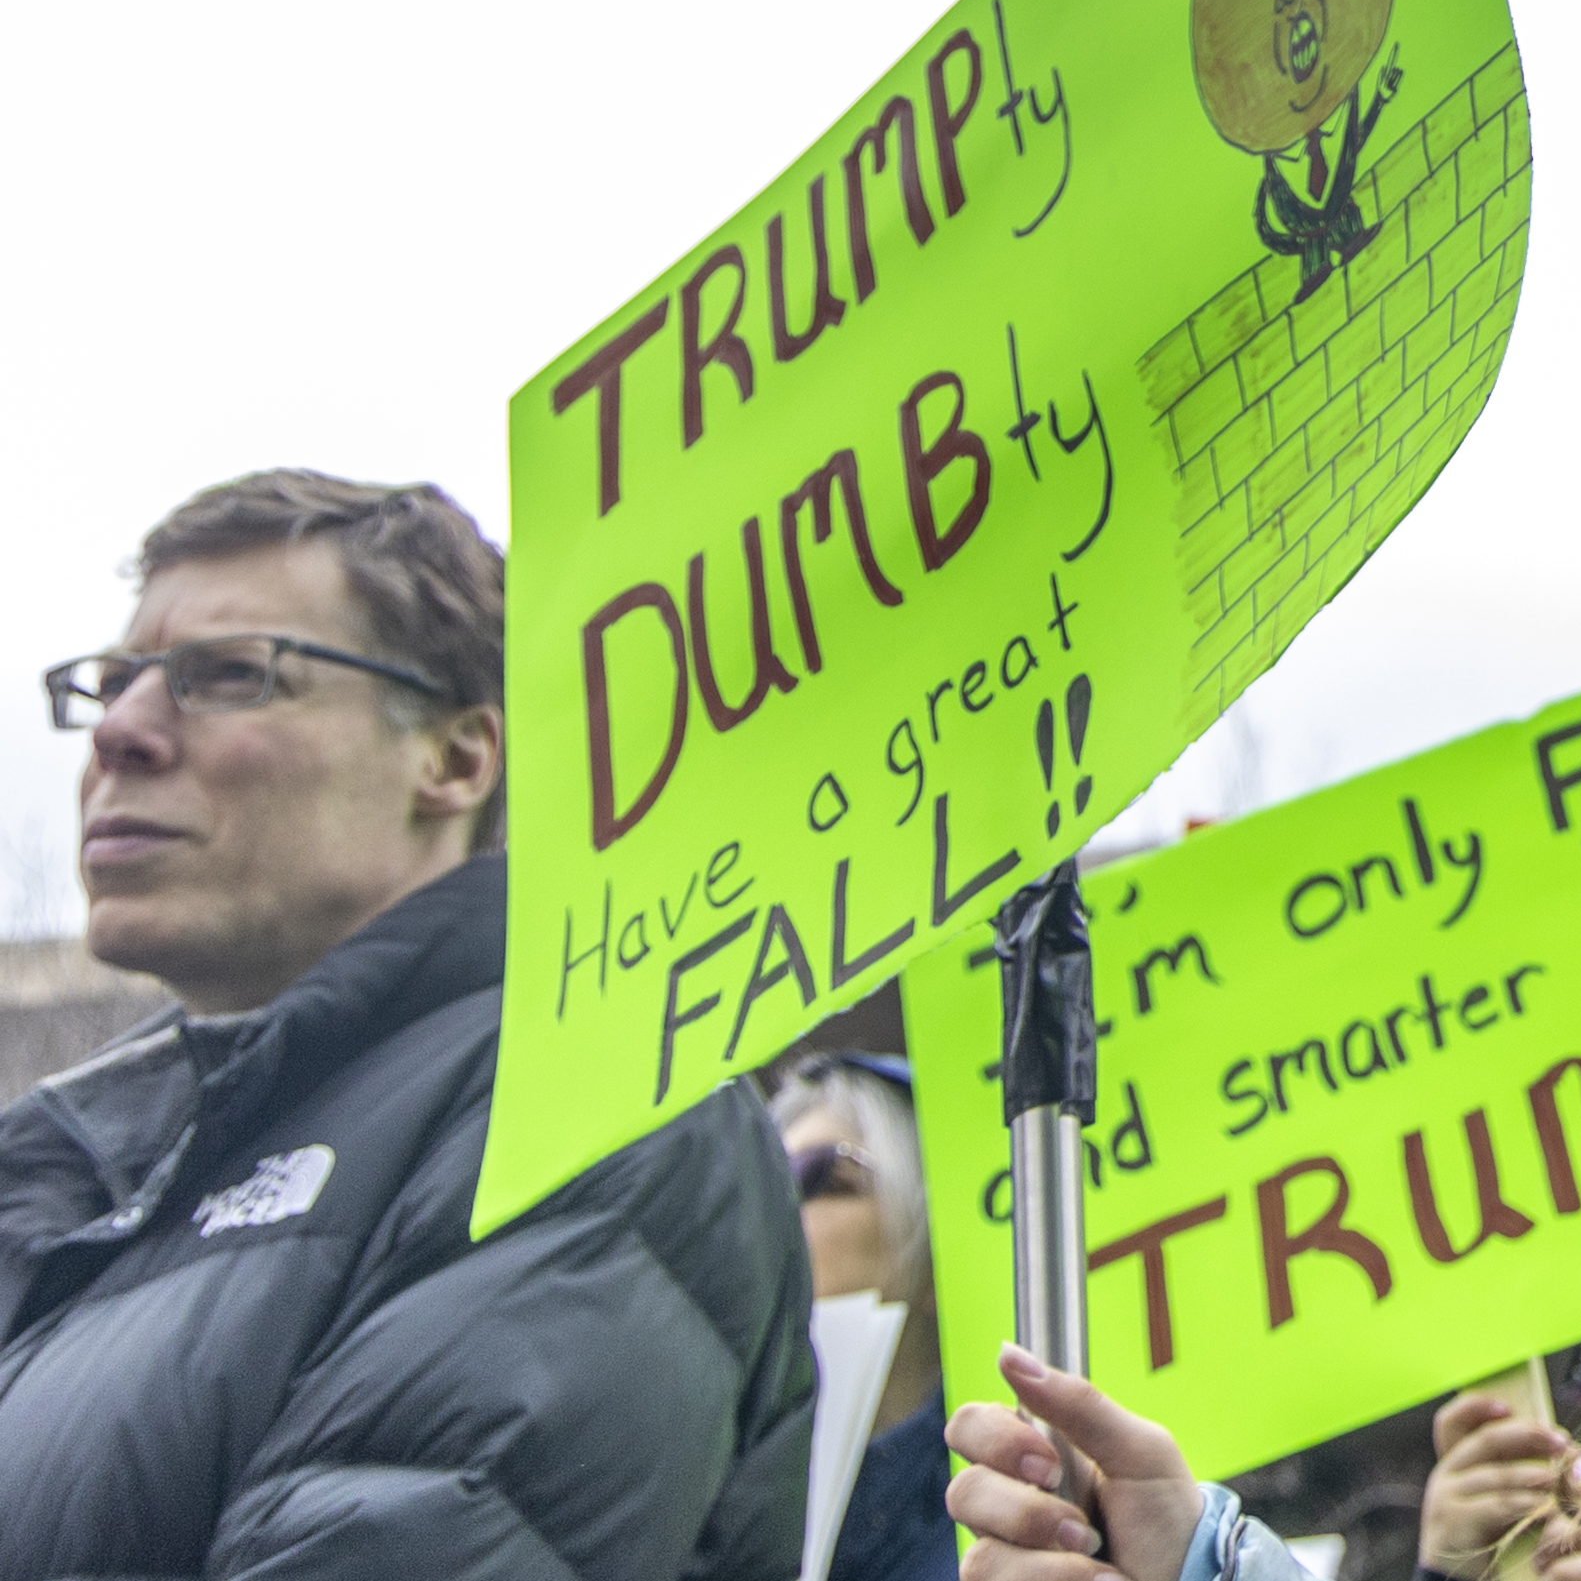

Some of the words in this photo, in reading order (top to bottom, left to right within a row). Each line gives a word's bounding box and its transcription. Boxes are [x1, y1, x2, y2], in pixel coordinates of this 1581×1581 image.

[558, 838, 755, 1022] Have
[806, 768, 854, 833] a
[885, 572, 1081, 826] great
[1284, 797, 1484, 931] only
[1221, 964, 1543, 1138] smarter
